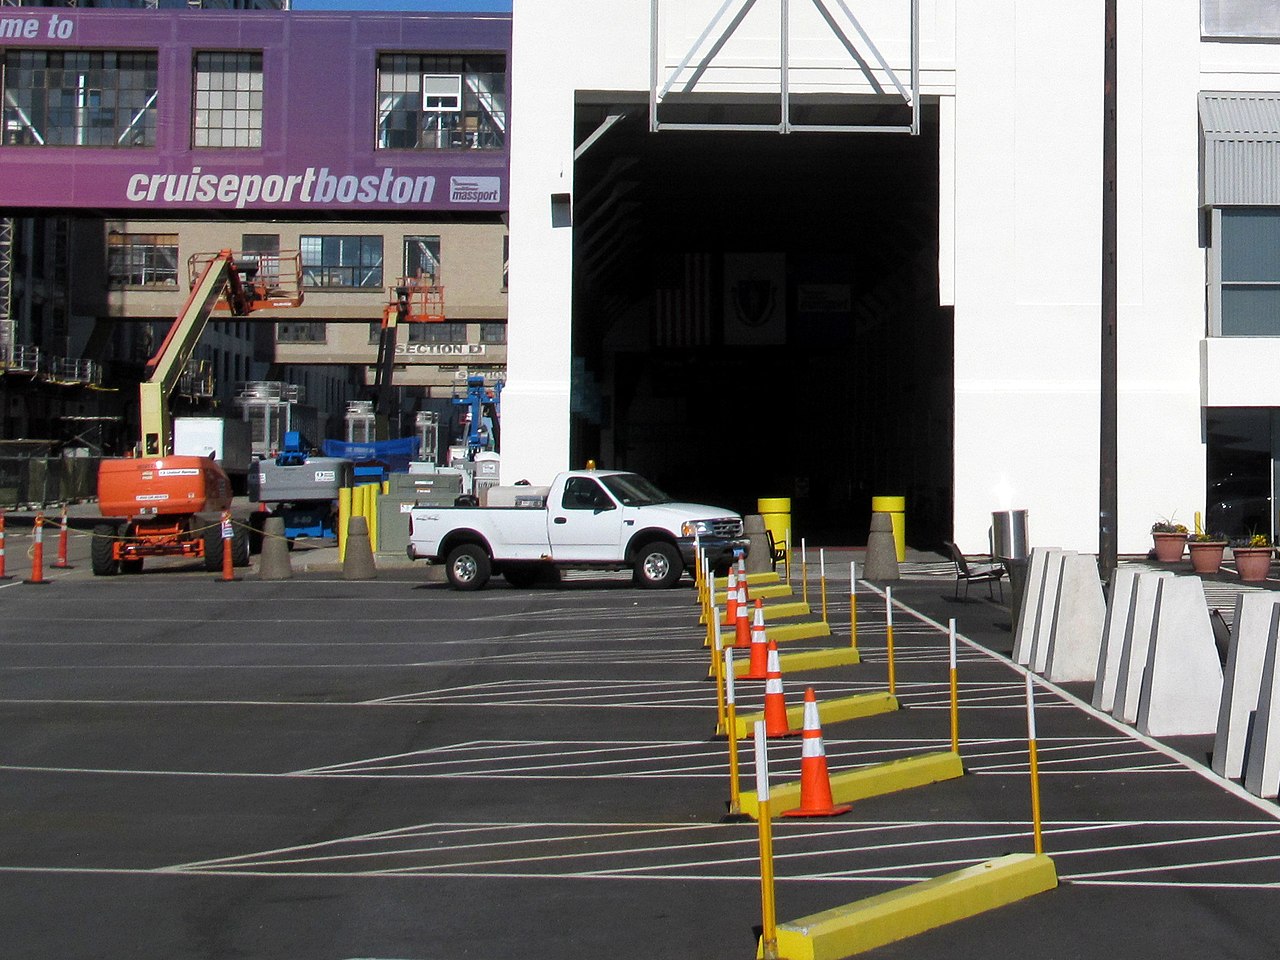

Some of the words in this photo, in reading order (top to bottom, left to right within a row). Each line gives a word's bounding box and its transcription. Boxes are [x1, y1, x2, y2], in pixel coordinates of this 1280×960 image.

[48, 14, 73, 39] to
[452, 189, 498, 203] massport
[395, 344, 462, 354] SECTION
[469, 345, 482, 353] D
